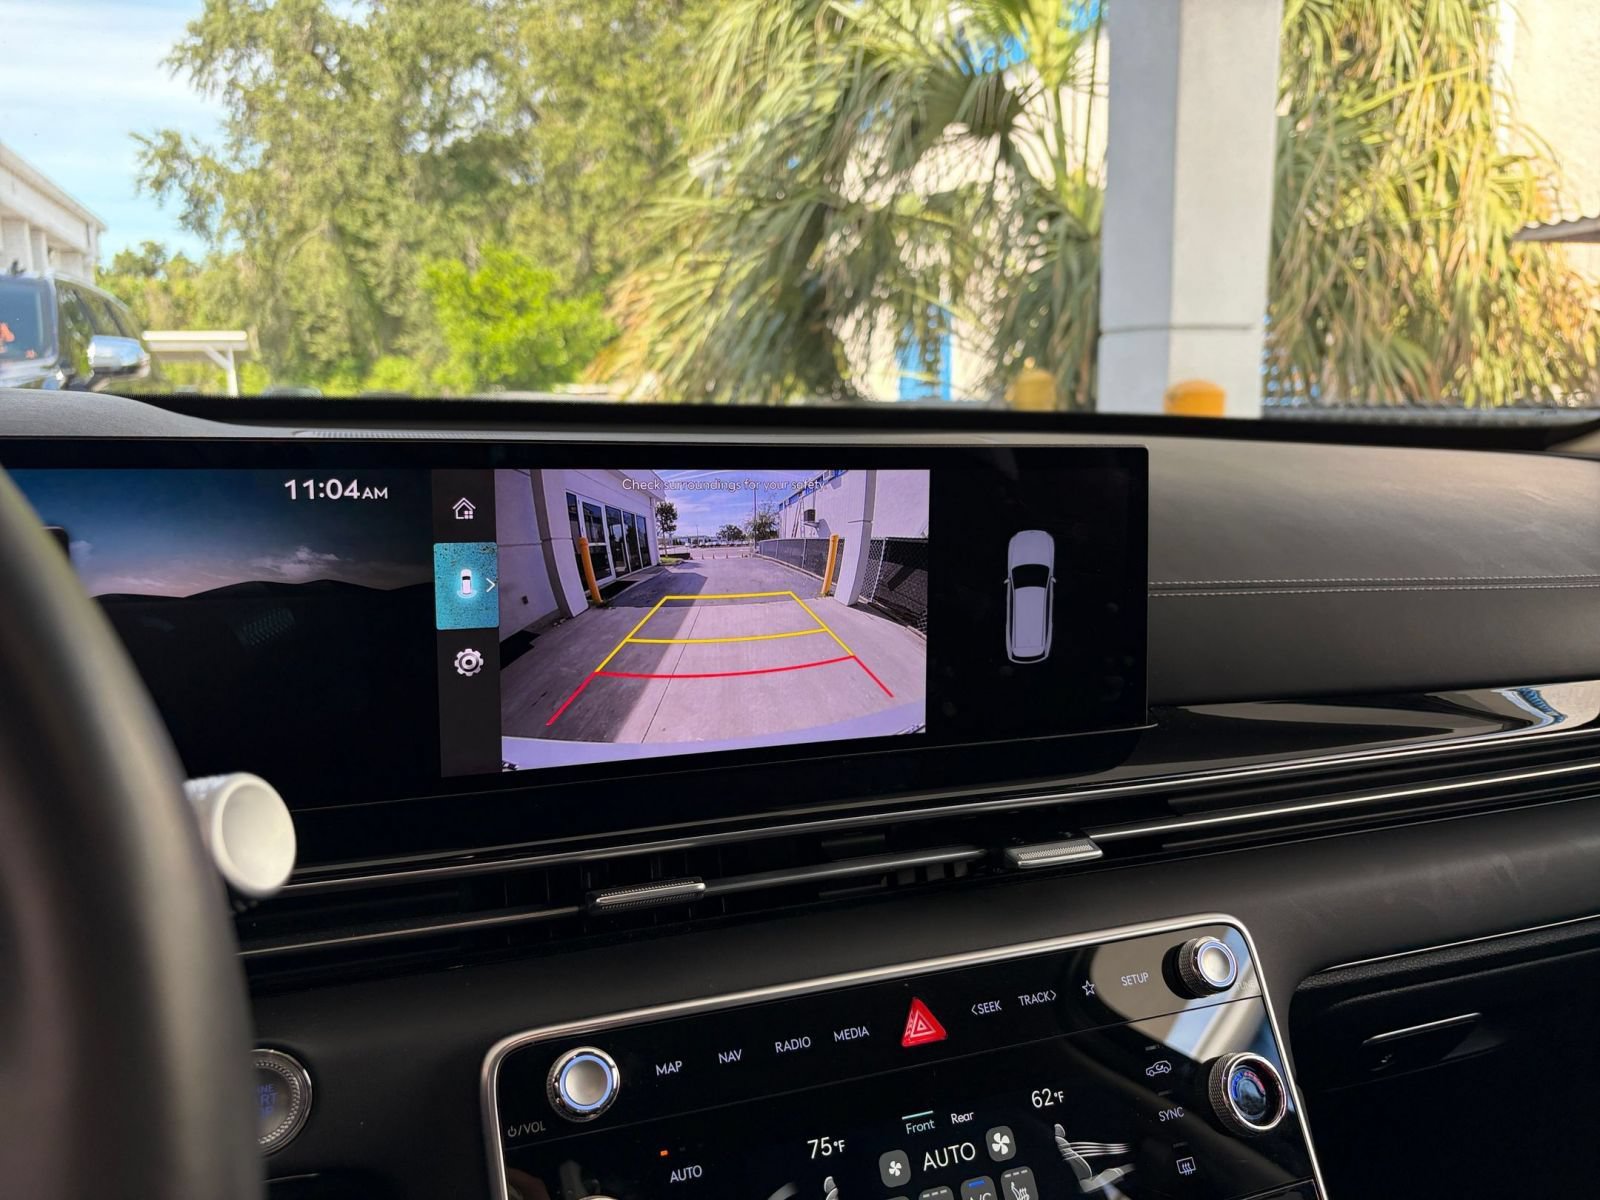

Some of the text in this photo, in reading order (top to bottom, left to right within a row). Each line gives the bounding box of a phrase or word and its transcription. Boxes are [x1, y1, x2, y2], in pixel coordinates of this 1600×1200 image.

[621, 478, 660, 491] Check
[663, 478, 742, 493] surroundings
[744, 478, 760, 490] for
[763, 481, 788, 494] your
[1120, 971, 1149, 987] SETUP
[833, 1025, 870, 1042] MEDIA
[775, 1036, 812, 1053] RADIO
[718, 1049, 742, 1064] NAV
[655, 1060, 683, 1076] MAP
[950, 1111, 975, 1124] Rear
[1158, 1106, 1185, 1122] SYNC
[905, 1119, 936, 1135] Front
[923, 1142, 976, 1171] AUTO
[670, 1164, 703, 1184] AUTO
